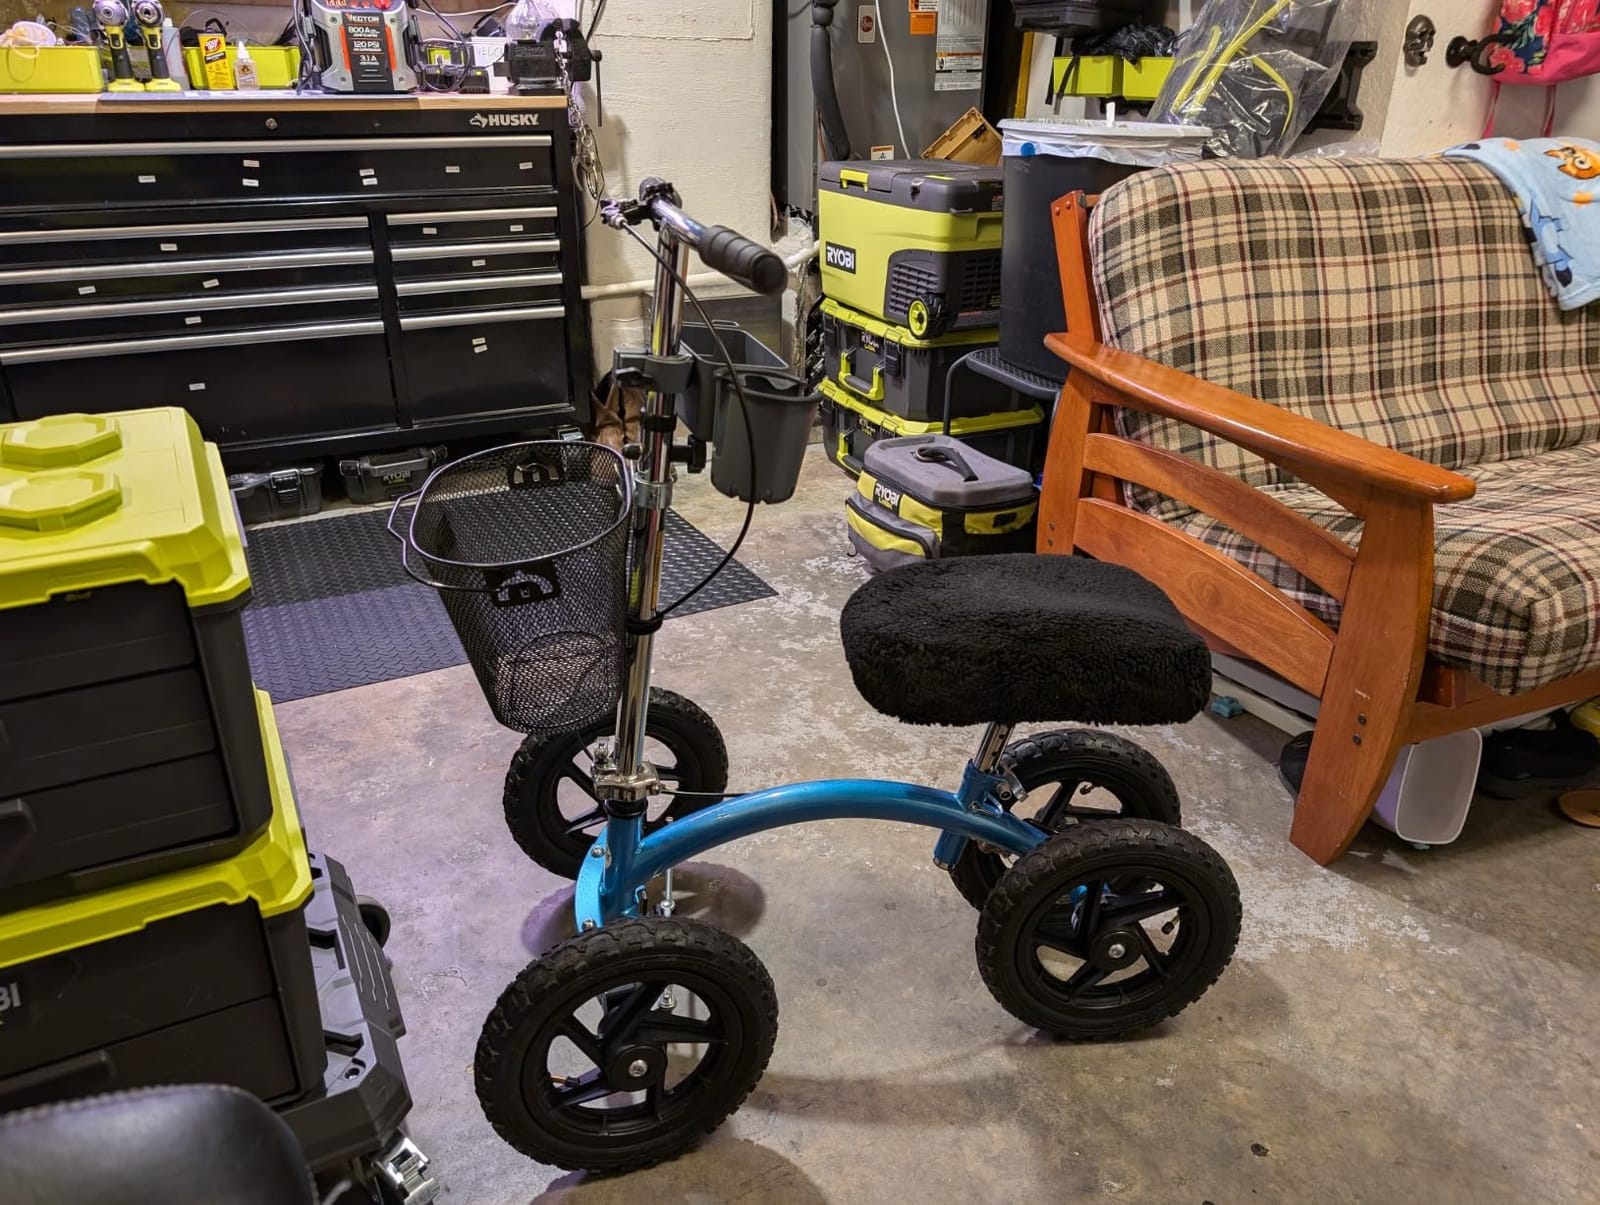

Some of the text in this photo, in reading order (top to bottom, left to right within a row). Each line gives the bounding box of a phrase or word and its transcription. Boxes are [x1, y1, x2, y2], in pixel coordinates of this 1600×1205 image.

[488, 113, 538, 126] HUSKY
[826, 245, 855, 270] RYOBI
[875, 482, 900, 506] RYOBI
